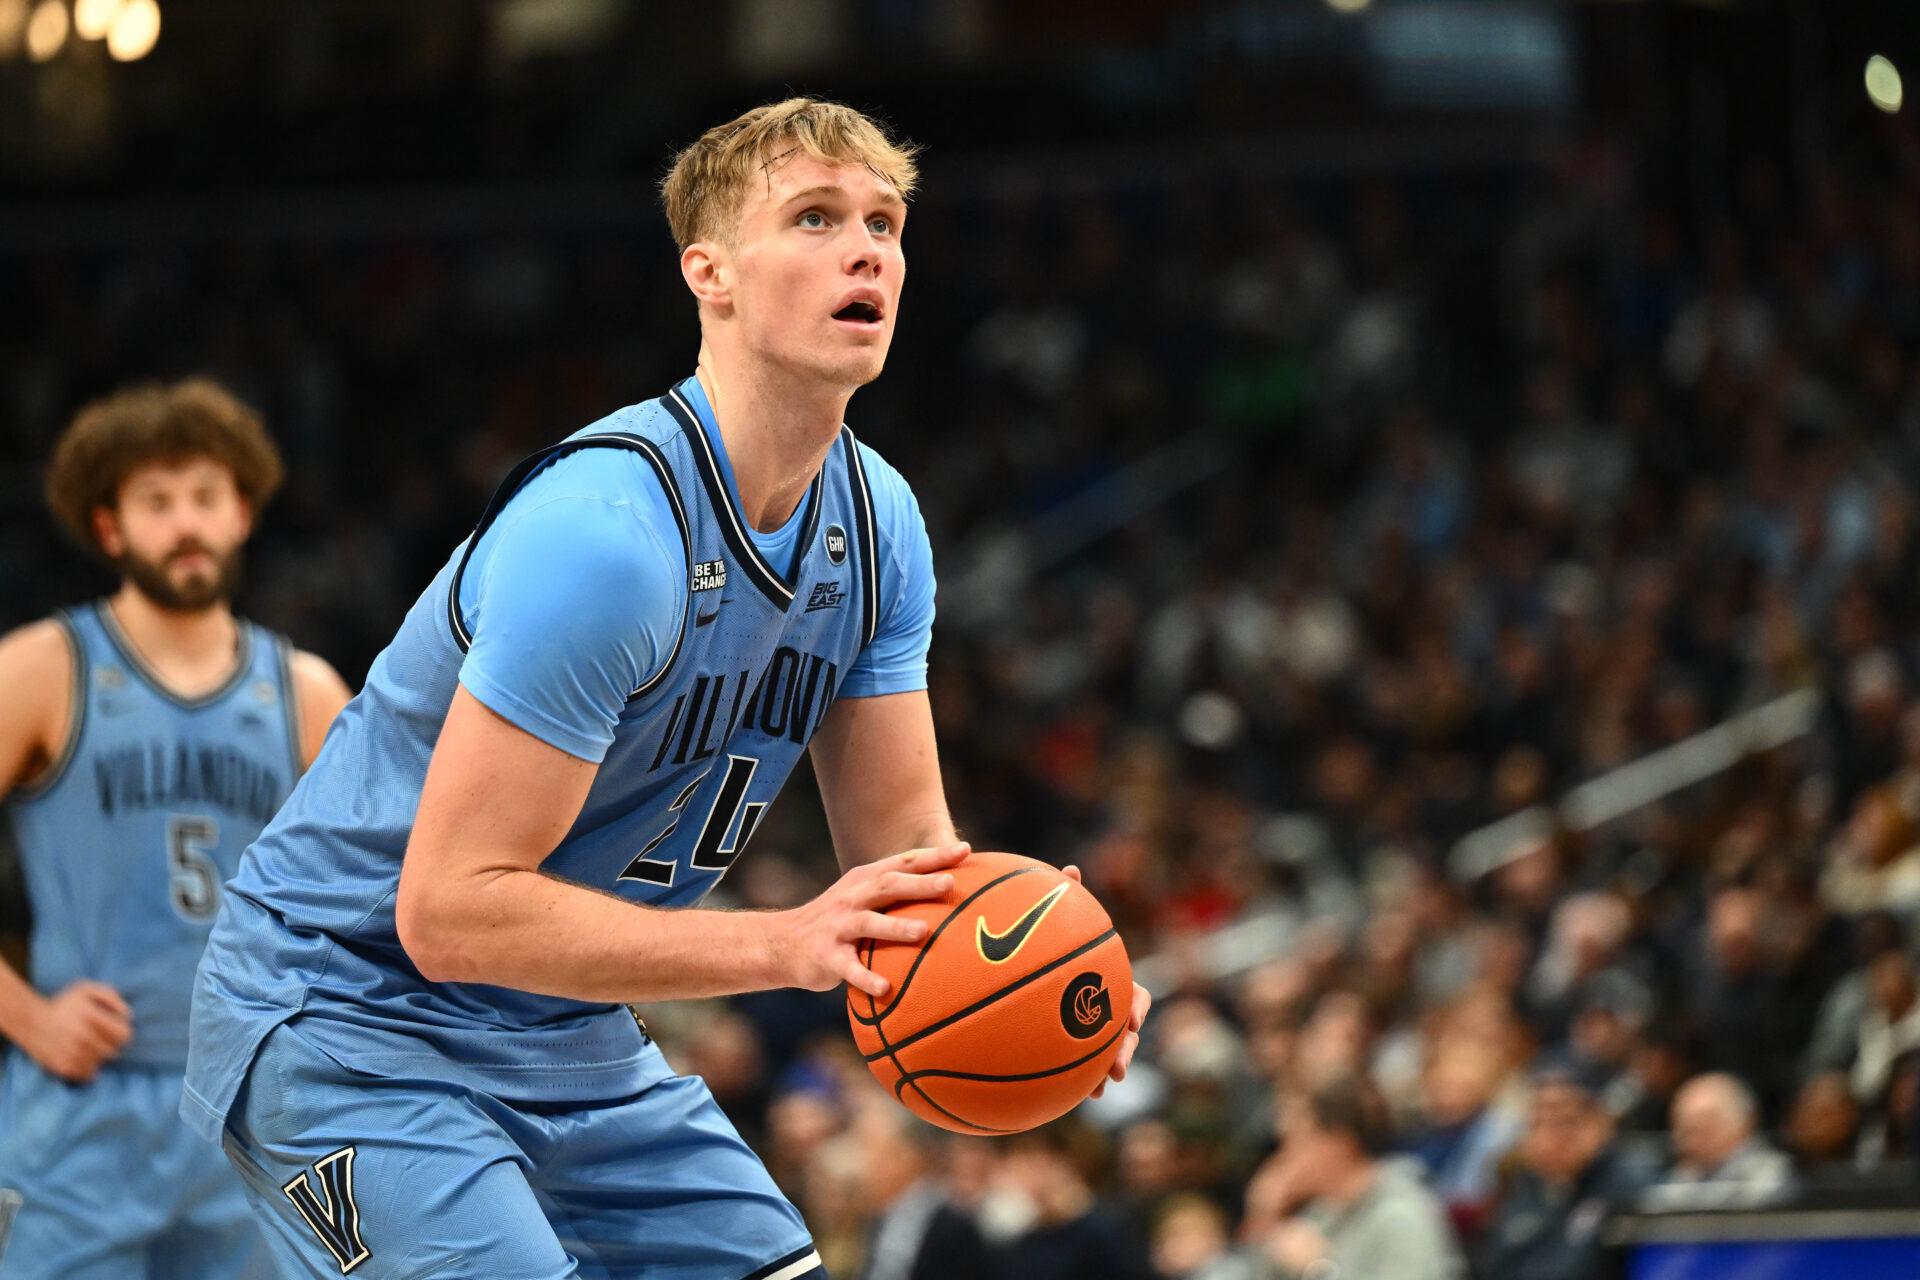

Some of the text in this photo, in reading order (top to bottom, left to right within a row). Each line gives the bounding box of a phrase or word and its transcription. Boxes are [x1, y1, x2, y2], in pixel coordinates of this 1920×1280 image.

[828, 537, 844, 553] GHR
[695, 559, 727, 577] BE TH
[814, 582, 840, 594] BIG
[808, 594, 846, 606] EAST
[617, 754, 767, 888] 24
[167, 814, 221, 925] 5
[281, 1145, 373, 1276] V
